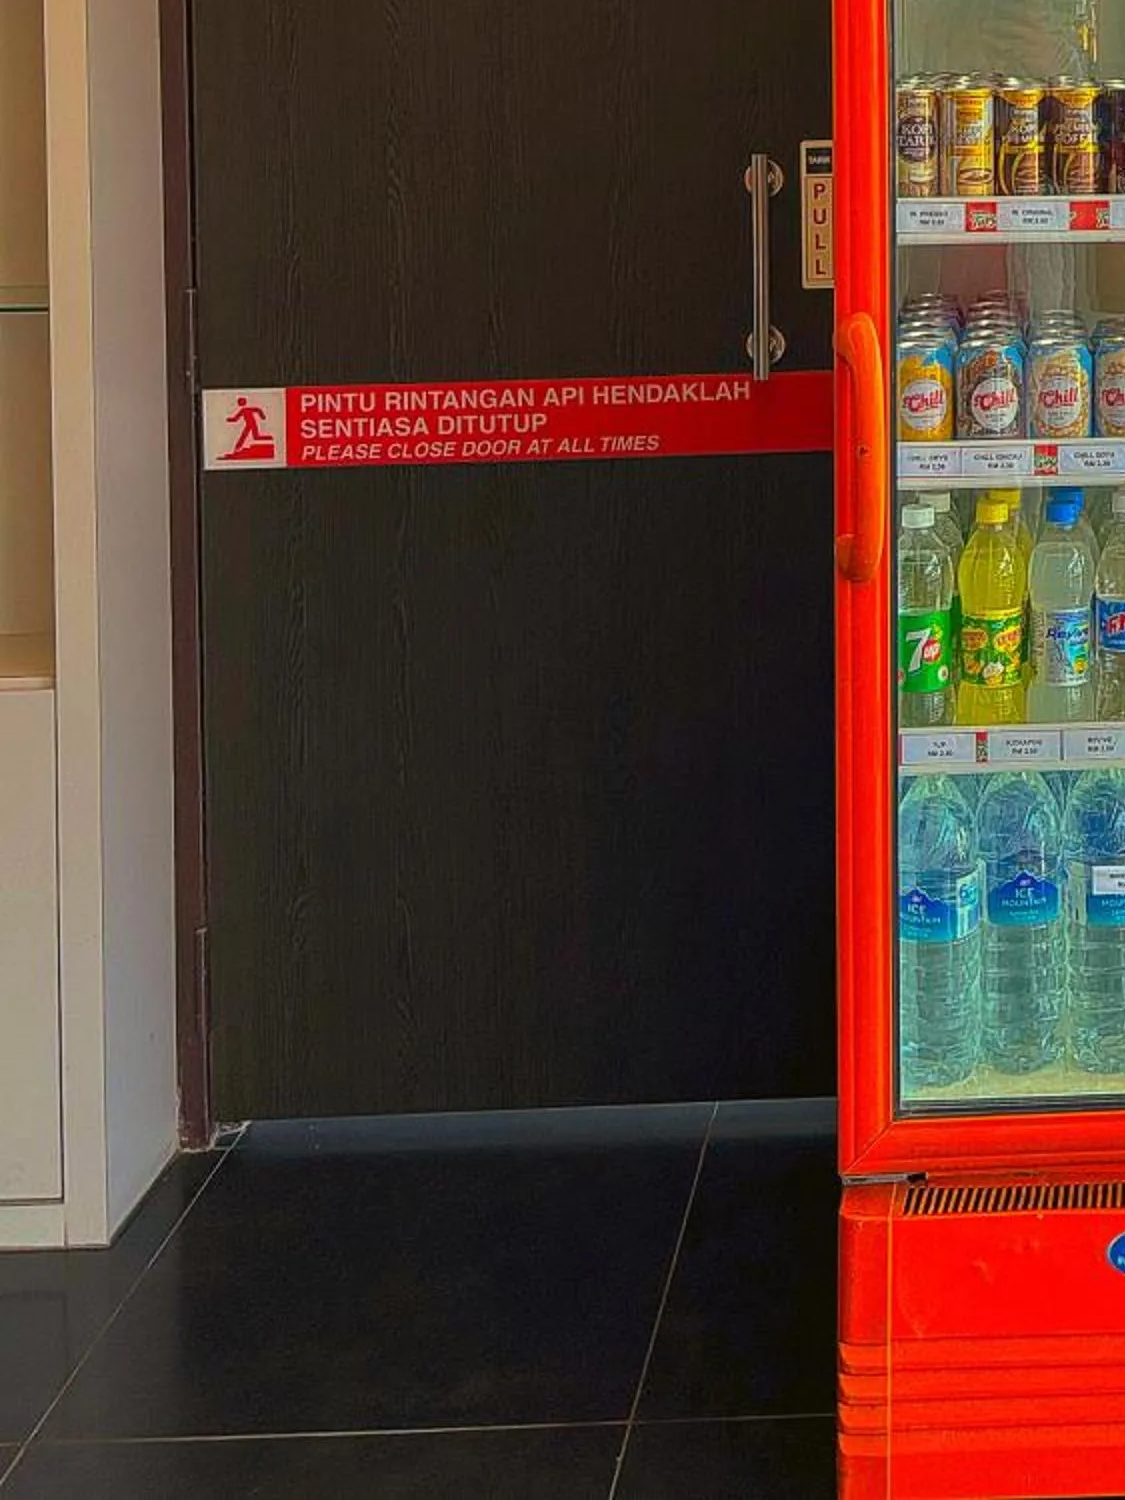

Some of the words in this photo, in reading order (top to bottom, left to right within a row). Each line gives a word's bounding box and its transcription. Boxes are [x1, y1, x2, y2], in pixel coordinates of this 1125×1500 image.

[813, 183, 827, 276] PULL
[301, 392, 376, 414] PINTU
[385, 388, 535, 411] RINTANGAN
[544, 386, 585, 406] API
[593, 380, 750, 405] HENDAKLAH
[300, 416, 429, 439] SENTIASA
[438, 413, 546, 435] DITUTUP
[302, 443, 382, 461] PLEASE
[387, 441, 457, 459] CLOSE
[461, 439, 521, 457] DOOR
[526, 438, 553, 455] AT
[557, 437, 595, 453] ALL
[600, 435, 660, 452] TIMES
[1015, 888, 1035, 898] ICE
[907, 904, 928, 914] ICE
